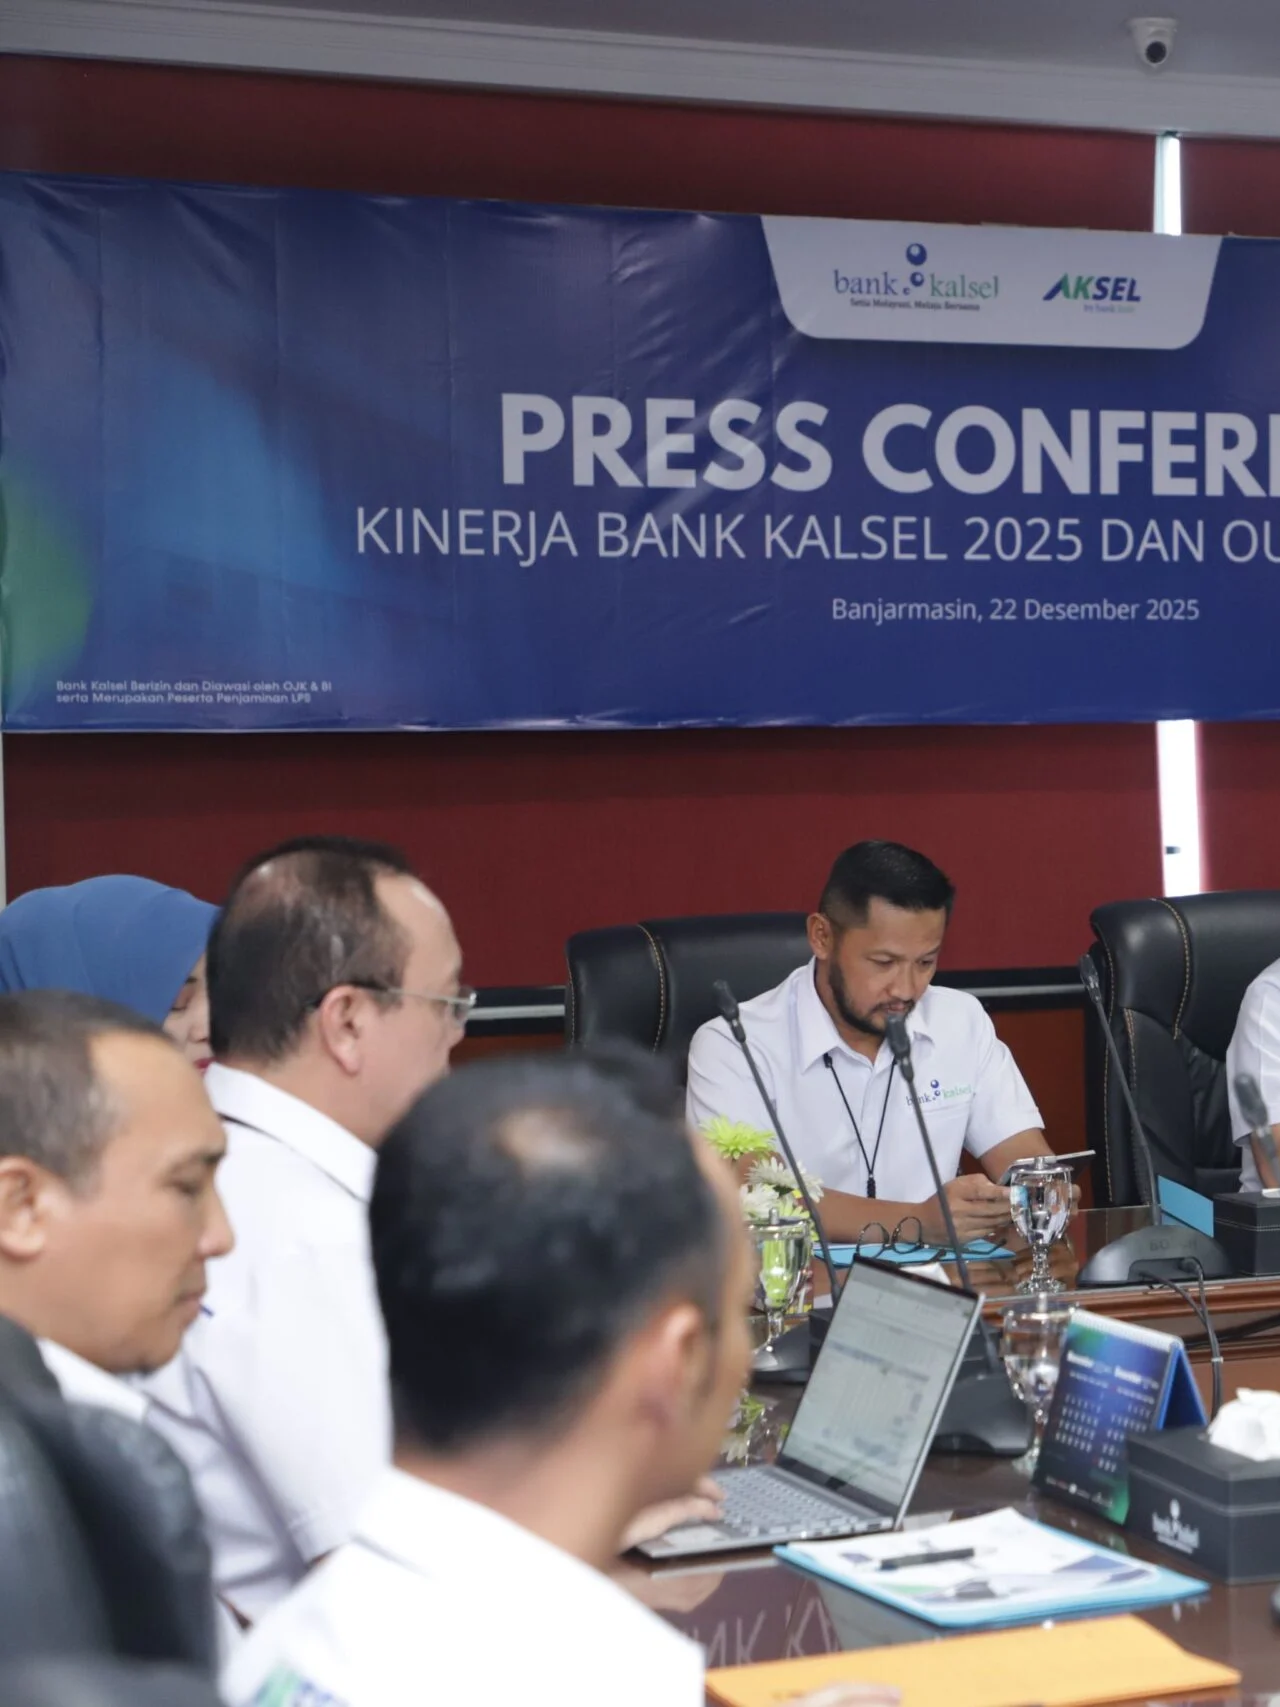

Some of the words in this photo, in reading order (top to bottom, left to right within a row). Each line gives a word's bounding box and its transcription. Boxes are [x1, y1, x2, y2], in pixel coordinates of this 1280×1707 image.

[834, 269, 898, 295] bank
[930, 273, 999, 299] kalsel
[1043, 272, 1141, 302] AKSEL
[502, 393, 833, 492] PRESS
[357, 507, 578, 567] KINERJA
[598, 512, 746, 558] BANK
[765, 515, 947, 560] KALSEL
[964, 516, 1083, 562] 2025
[1102, 519, 1204, 562] DAN
[832, 598, 983, 626] Banjarmasin,
[989, 599, 1017, 620] 22
[1025, 599, 1139, 620] Desember
[1146, 599, 1200, 621] 2025
[56, 680, 87, 691] Bank
[91, 680, 127, 691] Kalsel
[131, 680, 172, 691] Berizin
[174, 680, 198, 691] dan
[202, 681, 250, 691] Diawasi
[253, 681, 280, 691] oleh
[283, 682, 307, 691] OJK
[310, 682, 318, 691] &
[321, 682, 332, 691] BI
[56, 693, 88, 703] serta
[93, 693, 164, 704] Merupakan
[168, 693, 213, 703] Peserta
[217, 693, 288, 705] Penjaminan
[291, 694, 311, 703] LPS
